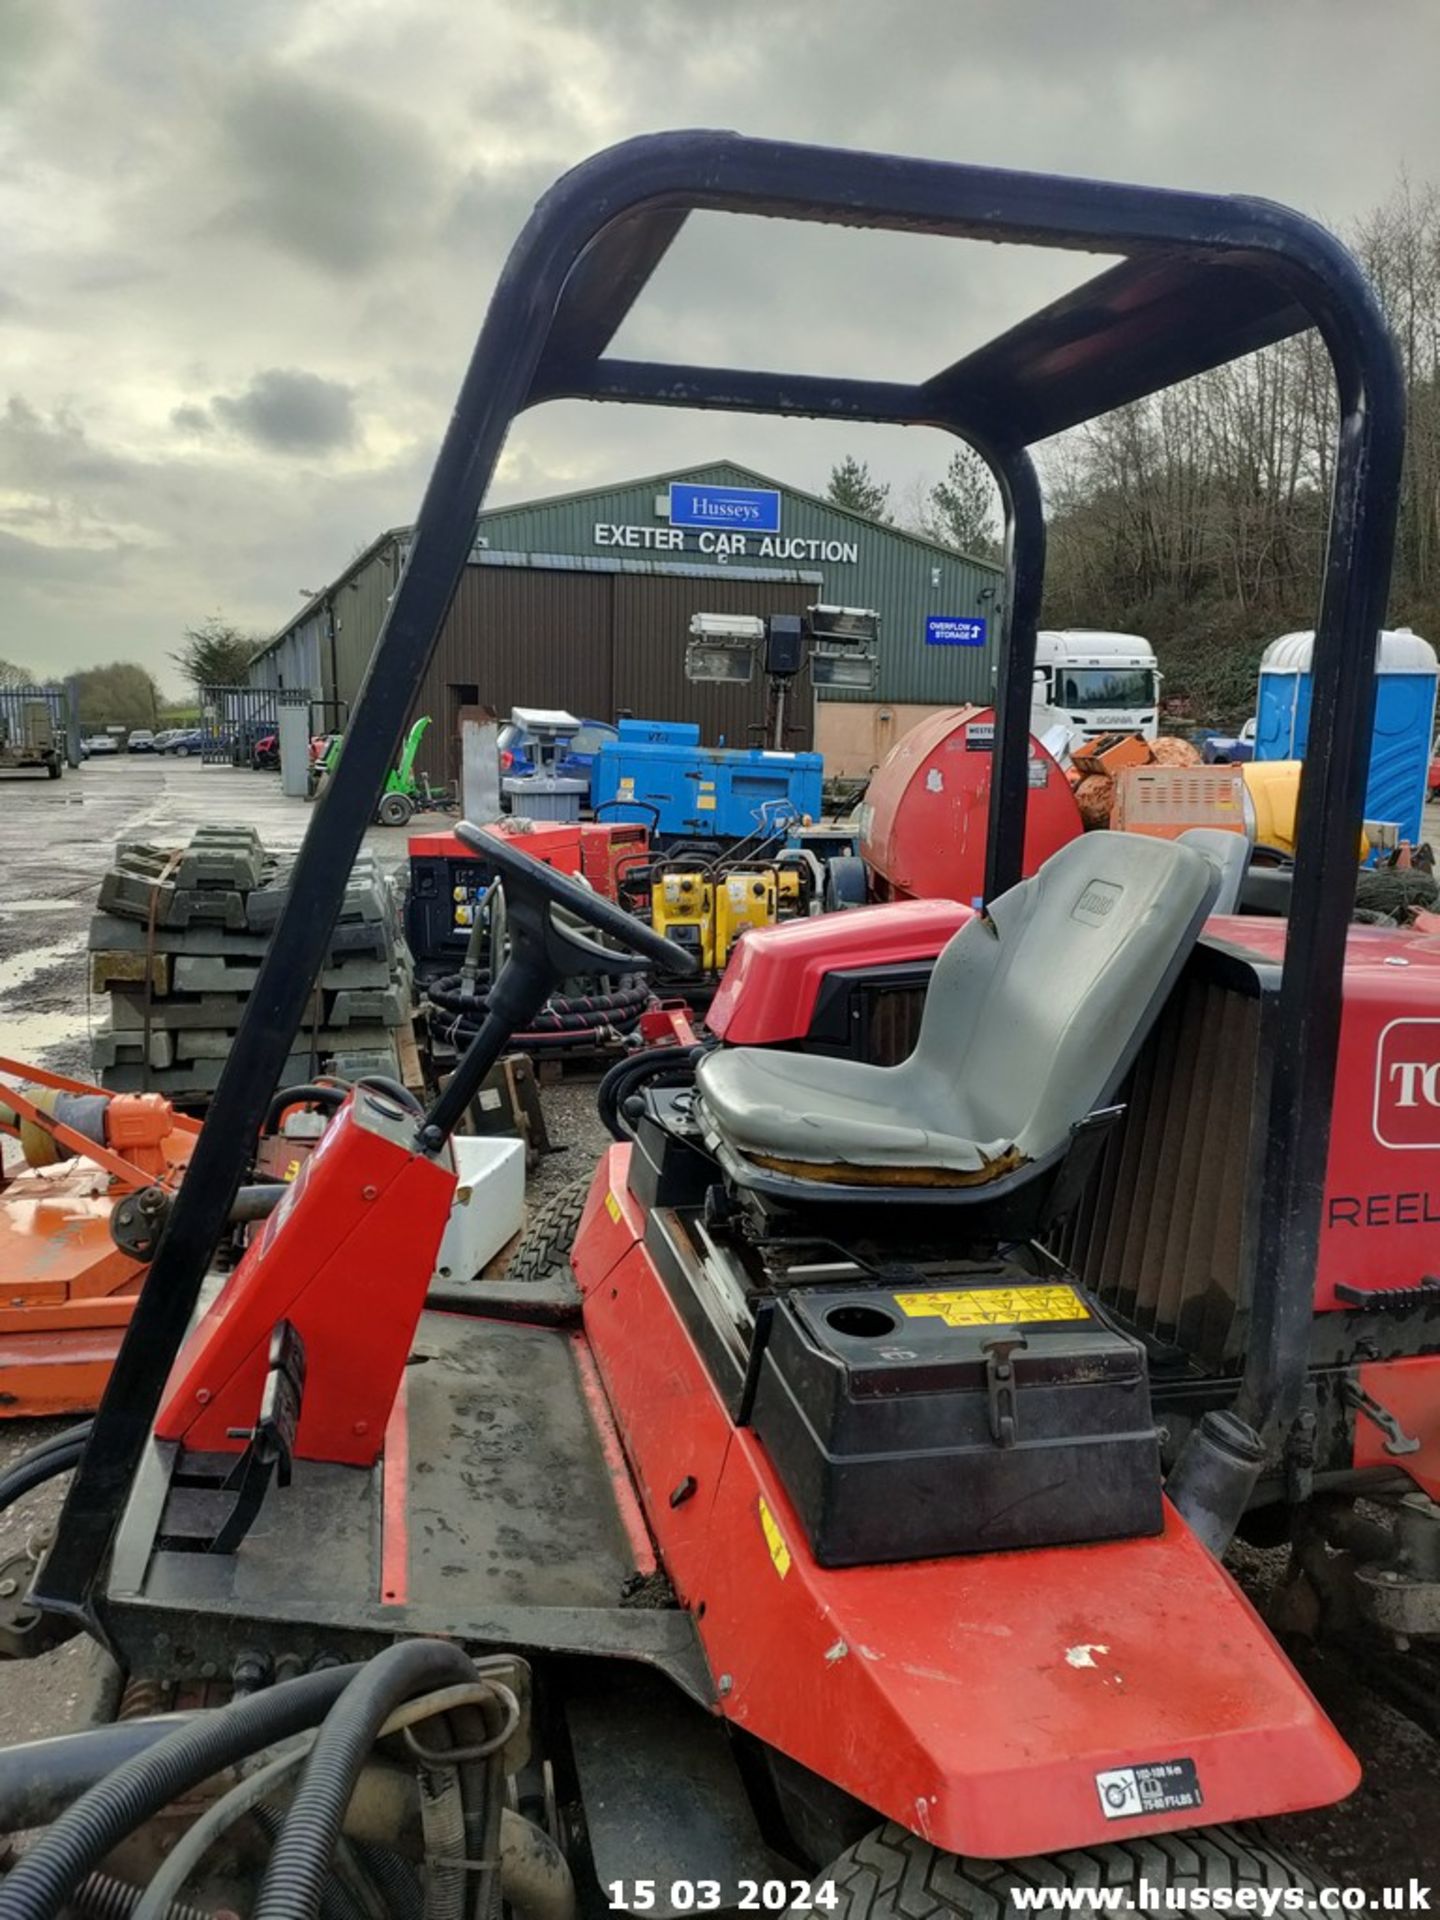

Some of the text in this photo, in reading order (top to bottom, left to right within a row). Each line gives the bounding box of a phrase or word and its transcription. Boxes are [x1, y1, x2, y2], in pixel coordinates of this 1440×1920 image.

[692, 497, 760, 522] Husseys
[594, 523, 858, 563] EXETER CAR AUCTION
[930, 622, 970, 631] OVERFLOW
[935, 631, 970, 640] STORAGE
[1096, 716, 1133, 725] SCANIA
[1328, 1192, 1440, 1228] REEL
